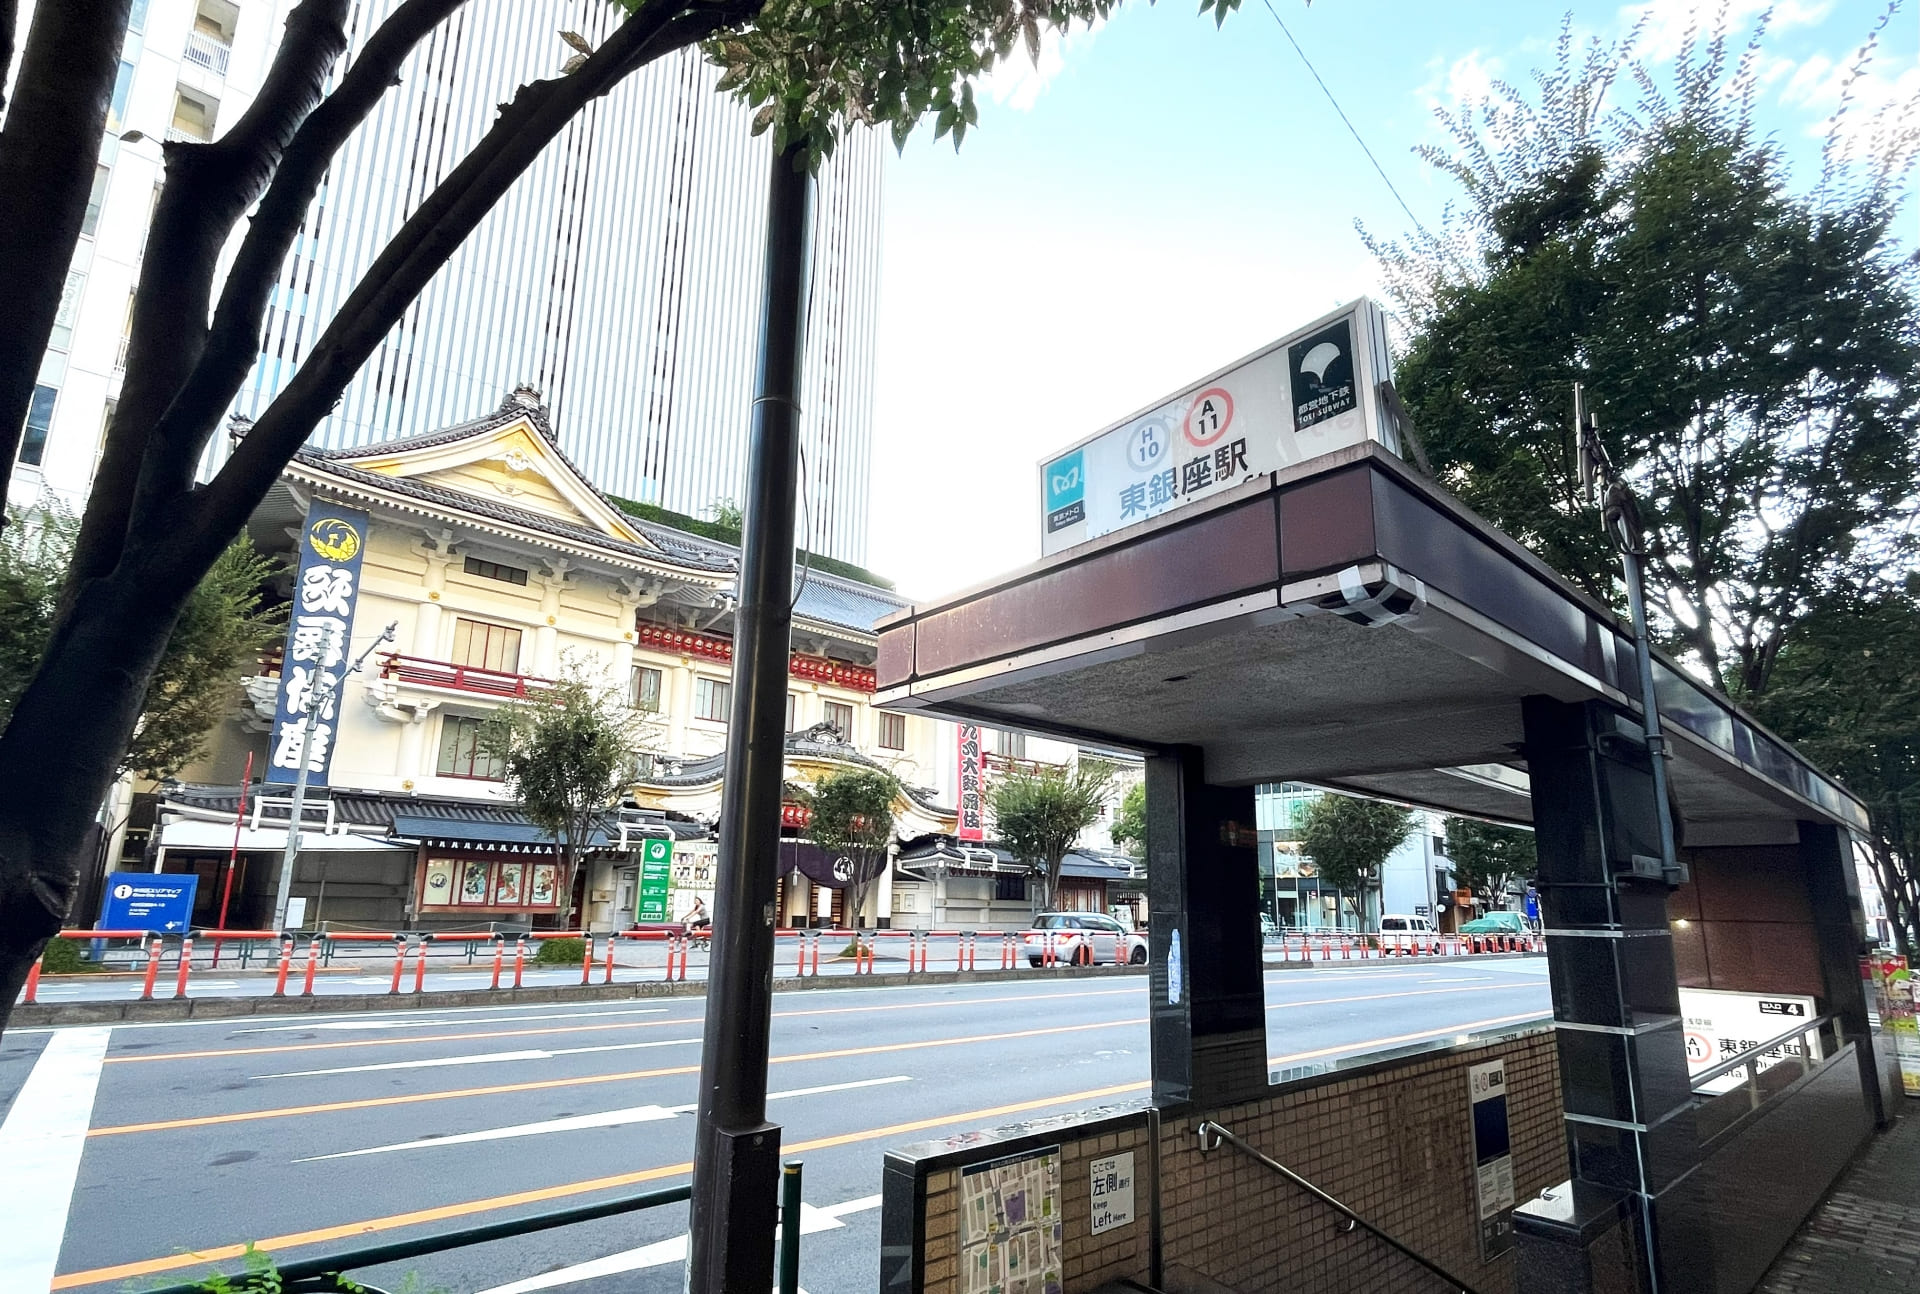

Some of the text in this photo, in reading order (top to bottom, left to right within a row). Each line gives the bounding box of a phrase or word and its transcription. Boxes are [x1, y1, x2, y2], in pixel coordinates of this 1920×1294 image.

[1201, 399, 1215, 417] A
[1298, 386, 1351, 416] 都営地下鉄
[1298, 397, 1351, 424] TOEI SUBWAY
[1198, 413, 1218, 435] 11
[1141, 426, 1153, 444] H
[1139, 441, 1160, 462] 10
[1119, 437, 1249, 520] 東銀座駅
[1787, 1004, 1799, 1015] 4
[1688, 1038, 1698, 1046] A
[1687, 1047, 1701, 1057] 11
[1092, 1161, 1115, 1174] ここでは
[1093, 1201, 1107, 1210] Keep
[1093, 1211, 1127, 1228] Left Here
